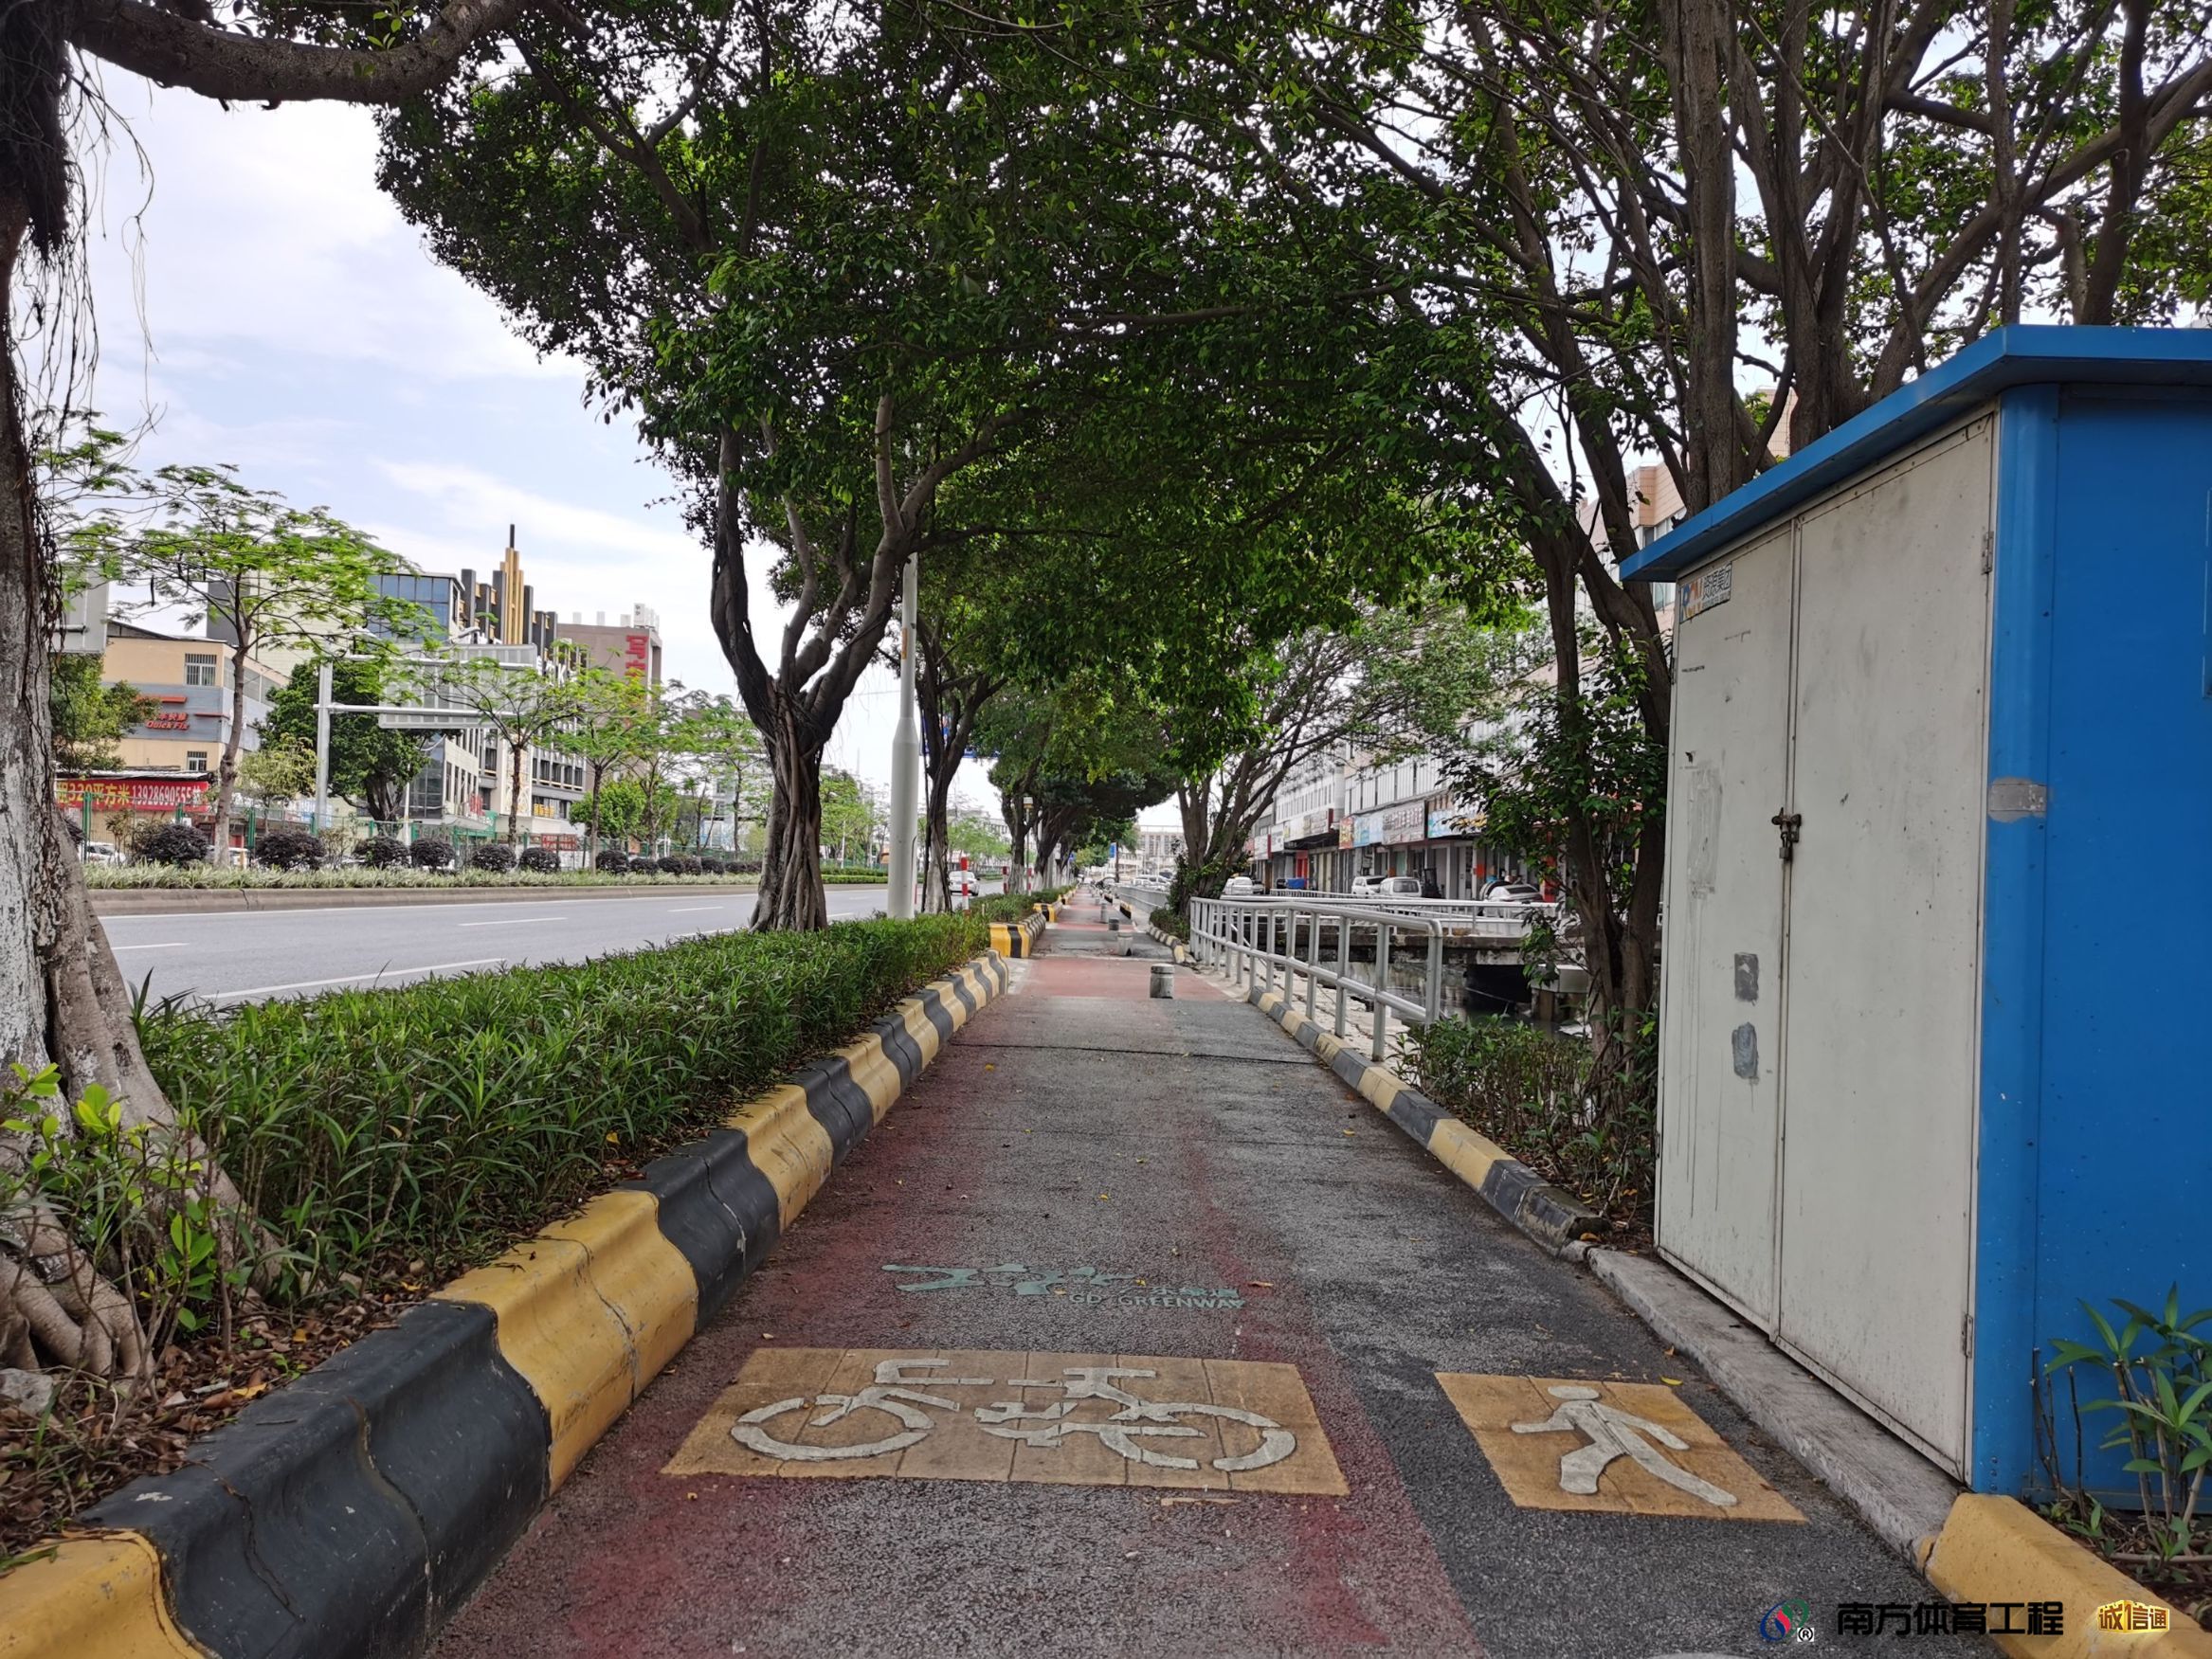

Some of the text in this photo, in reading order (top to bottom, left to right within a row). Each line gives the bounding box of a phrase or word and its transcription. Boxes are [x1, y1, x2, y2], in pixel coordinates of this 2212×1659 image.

[145, 720, 189, 730] Quick Fix
[1068, 1293, 1246, 1308] GD GREENWAY
